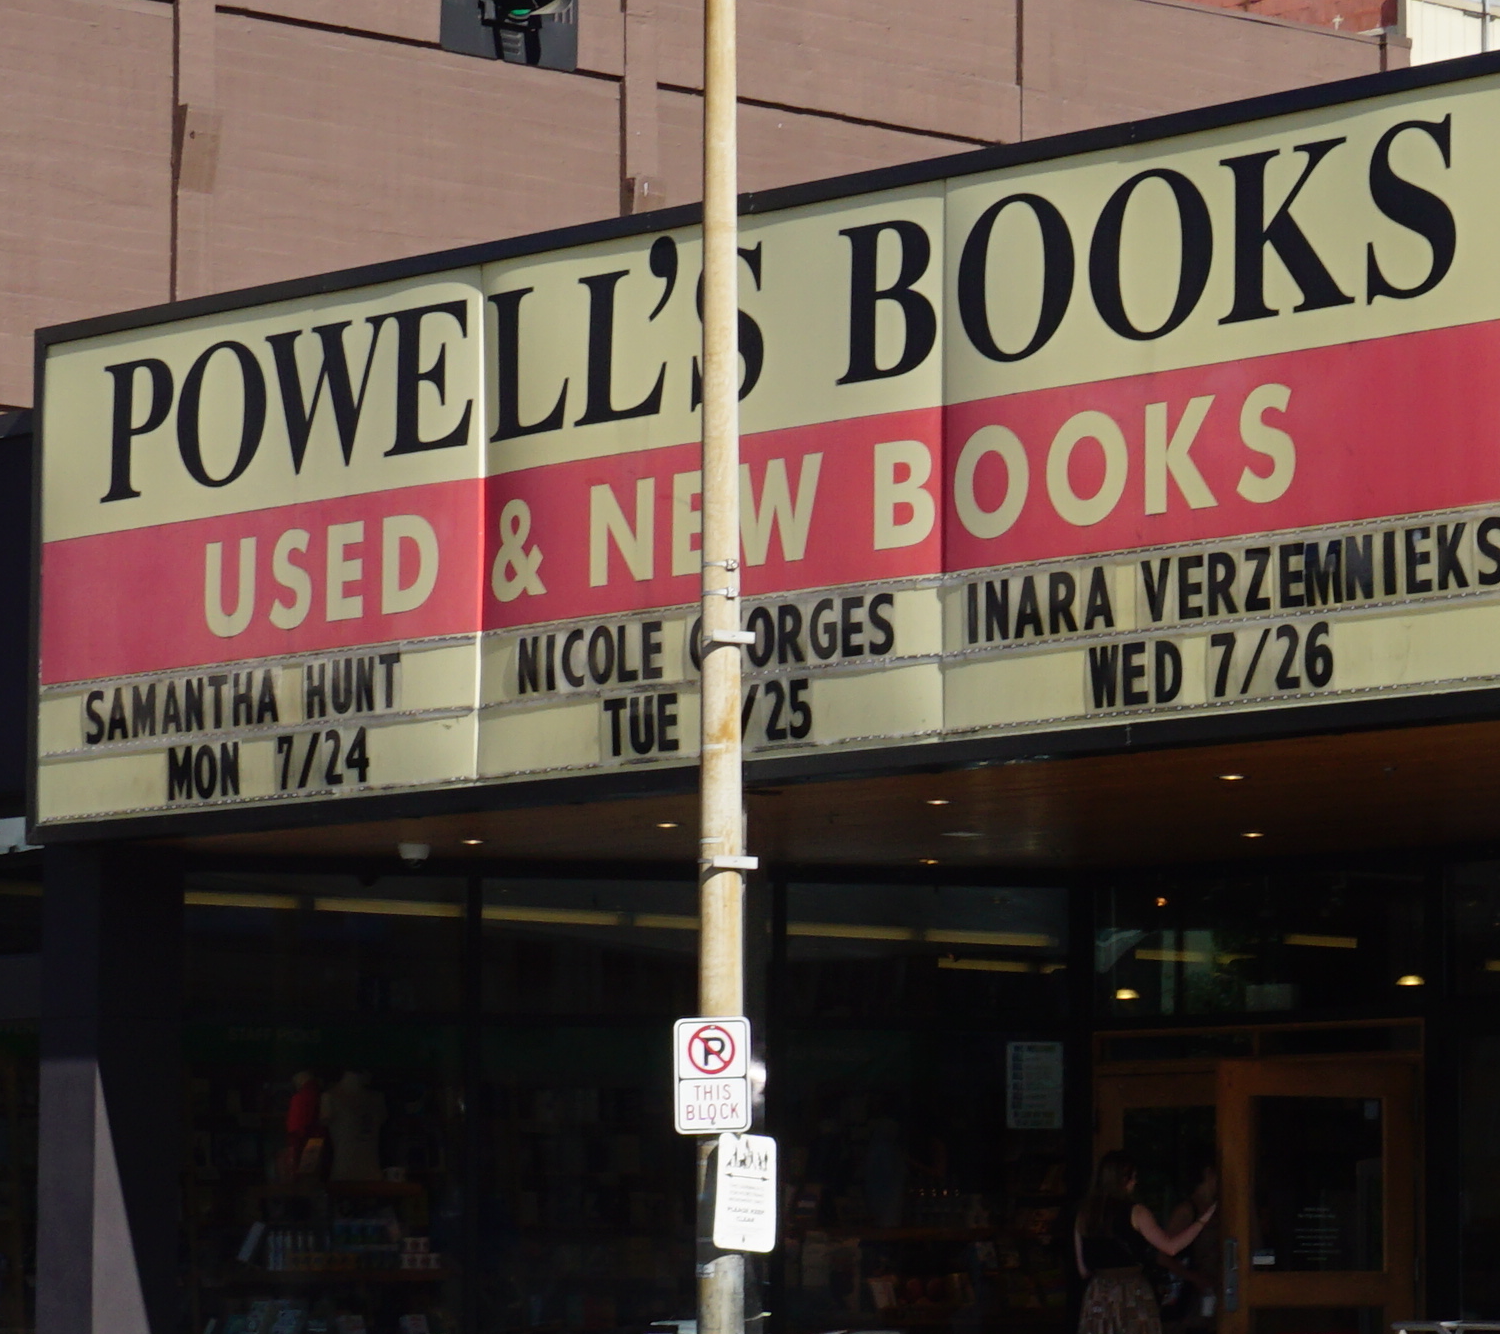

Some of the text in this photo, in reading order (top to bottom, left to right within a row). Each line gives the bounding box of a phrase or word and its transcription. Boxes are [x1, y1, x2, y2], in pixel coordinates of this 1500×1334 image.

[835, 111, 1458, 387] BOOKS
[202, 382, 1298, 641] USED & NEW BOOKS
[967, 565, 1114, 644] INARA
[516, 621, 664, 695] NICOLE
[1088, 621, 1334, 709] WED 7/26
[84, 653, 399, 744] SAMANTHA HUNT
[603, 693, 680, 758] TUE
[167, 725, 370, 801] MON 7/24
[686, 1103, 739, 1121] BLOCK
[694, 1084, 732, 1101] THIS
